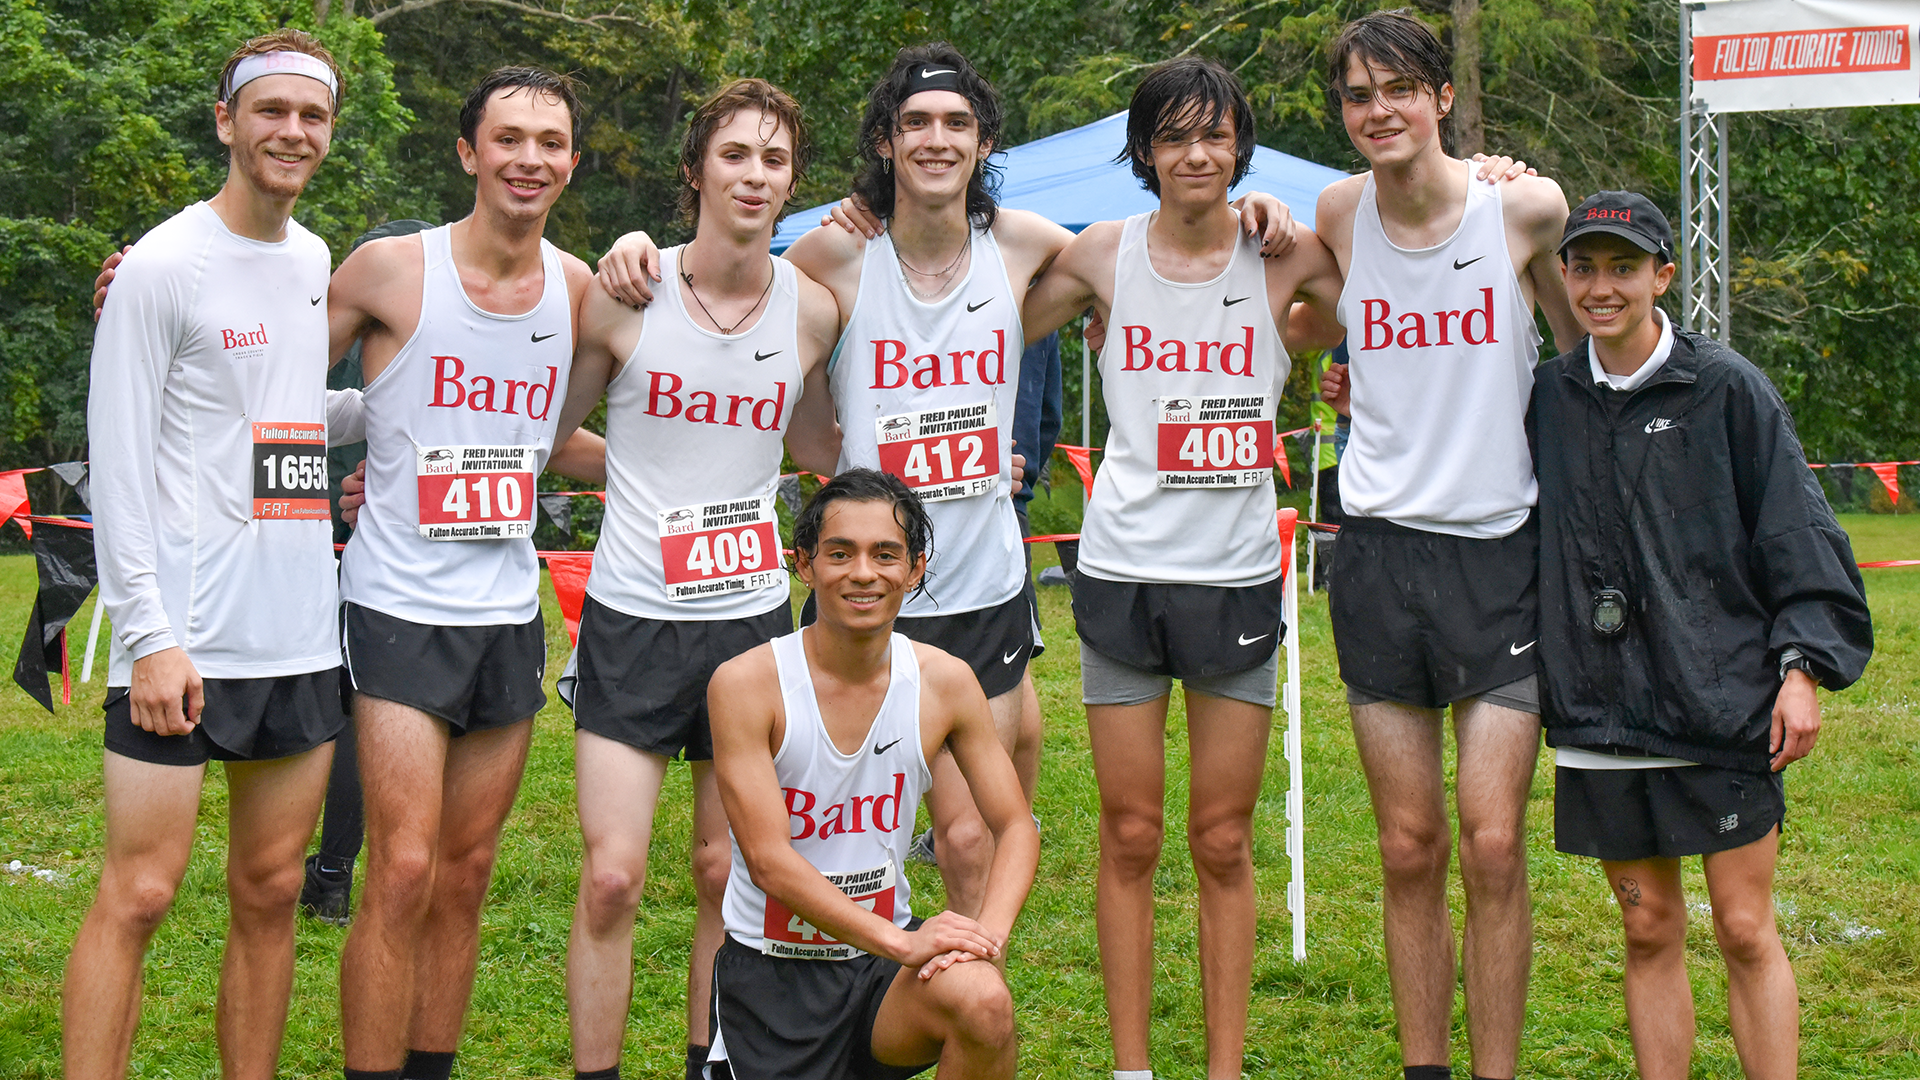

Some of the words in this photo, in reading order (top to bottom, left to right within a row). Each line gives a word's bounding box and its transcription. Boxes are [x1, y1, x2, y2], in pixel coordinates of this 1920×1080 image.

[1713, 37, 1770, 74] FULTON
[1770, 32, 1847, 70] ACCURATE
[1848, 29, 1903, 66] TIMING
[265, 53, 321, 73] Bard
[1585, 207, 1632, 223] Bard
[1361, 288, 1499, 356] Bard
[220, 323, 269, 350] Bard
[868, 329, 1006, 391] Bard
[1120, 325, 1255, 378] Bard
[427, 355, 558, 421] Bard
[643, 370, 787, 432] Bard
[1201, 398, 1226, 409] FRED
[1228, 396, 1264, 408] PAVLICH
[920, 411, 945, 424] FRED
[947, 404, 987, 419] PAVLICH
[1165, 412, 1190, 422] Bard
[1199, 408, 1262, 421] INVITATIONAL
[261, 427, 289, 439] Fulton
[289, 428, 318, 440] Accurate
[884, 429, 911, 442] Bard
[919, 417, 986, 436] INVITATIONAL
[463, 448, 487, 459] FRED
[488, 448, 525, 459] PAVLICH
[1179, 425, 1258, 468] 408
[426, 462, 453, 473] Bard
[461, 459, 523, 471] INVITATIONAL
[904, 435, 986, 483] 412
[263, 454, 329, 491] 16558
[1166, 474, 1186, 484] Fulton
[1186, 475, 1215, 484] Accurate
[1216, 473, 1237, 485] Timing
[442, 476, 522, 519] 410
[943, 484, 965, 496] Timing
[262, 503, 290, 517] FAT
[703, 503, 728, 517] FRED
[729, 499, 761, 513] PAVLICH
[667, 521, 694, 535] Bard
[702, 511, 760, 528] INVITATIONAL
[429, 527, 450, 538] Fulton
[451, 526, 479, 537] Accurate
[480, 525, 501, 537] Timing
[686, 529, 763, 576] 409
[676, 586, 696, 597] Fulton
[697, 582, 725, 594] Accurate
[725, 578, 745, 590] Timing
[781, 773, 906, 840] Bard
[845, 866, 887, 884] PAVLICH
[772, 943, 793, 955] Fulton
[794, 947, 825, 957] Accurate
[826, 947, 849, 958] Timing
